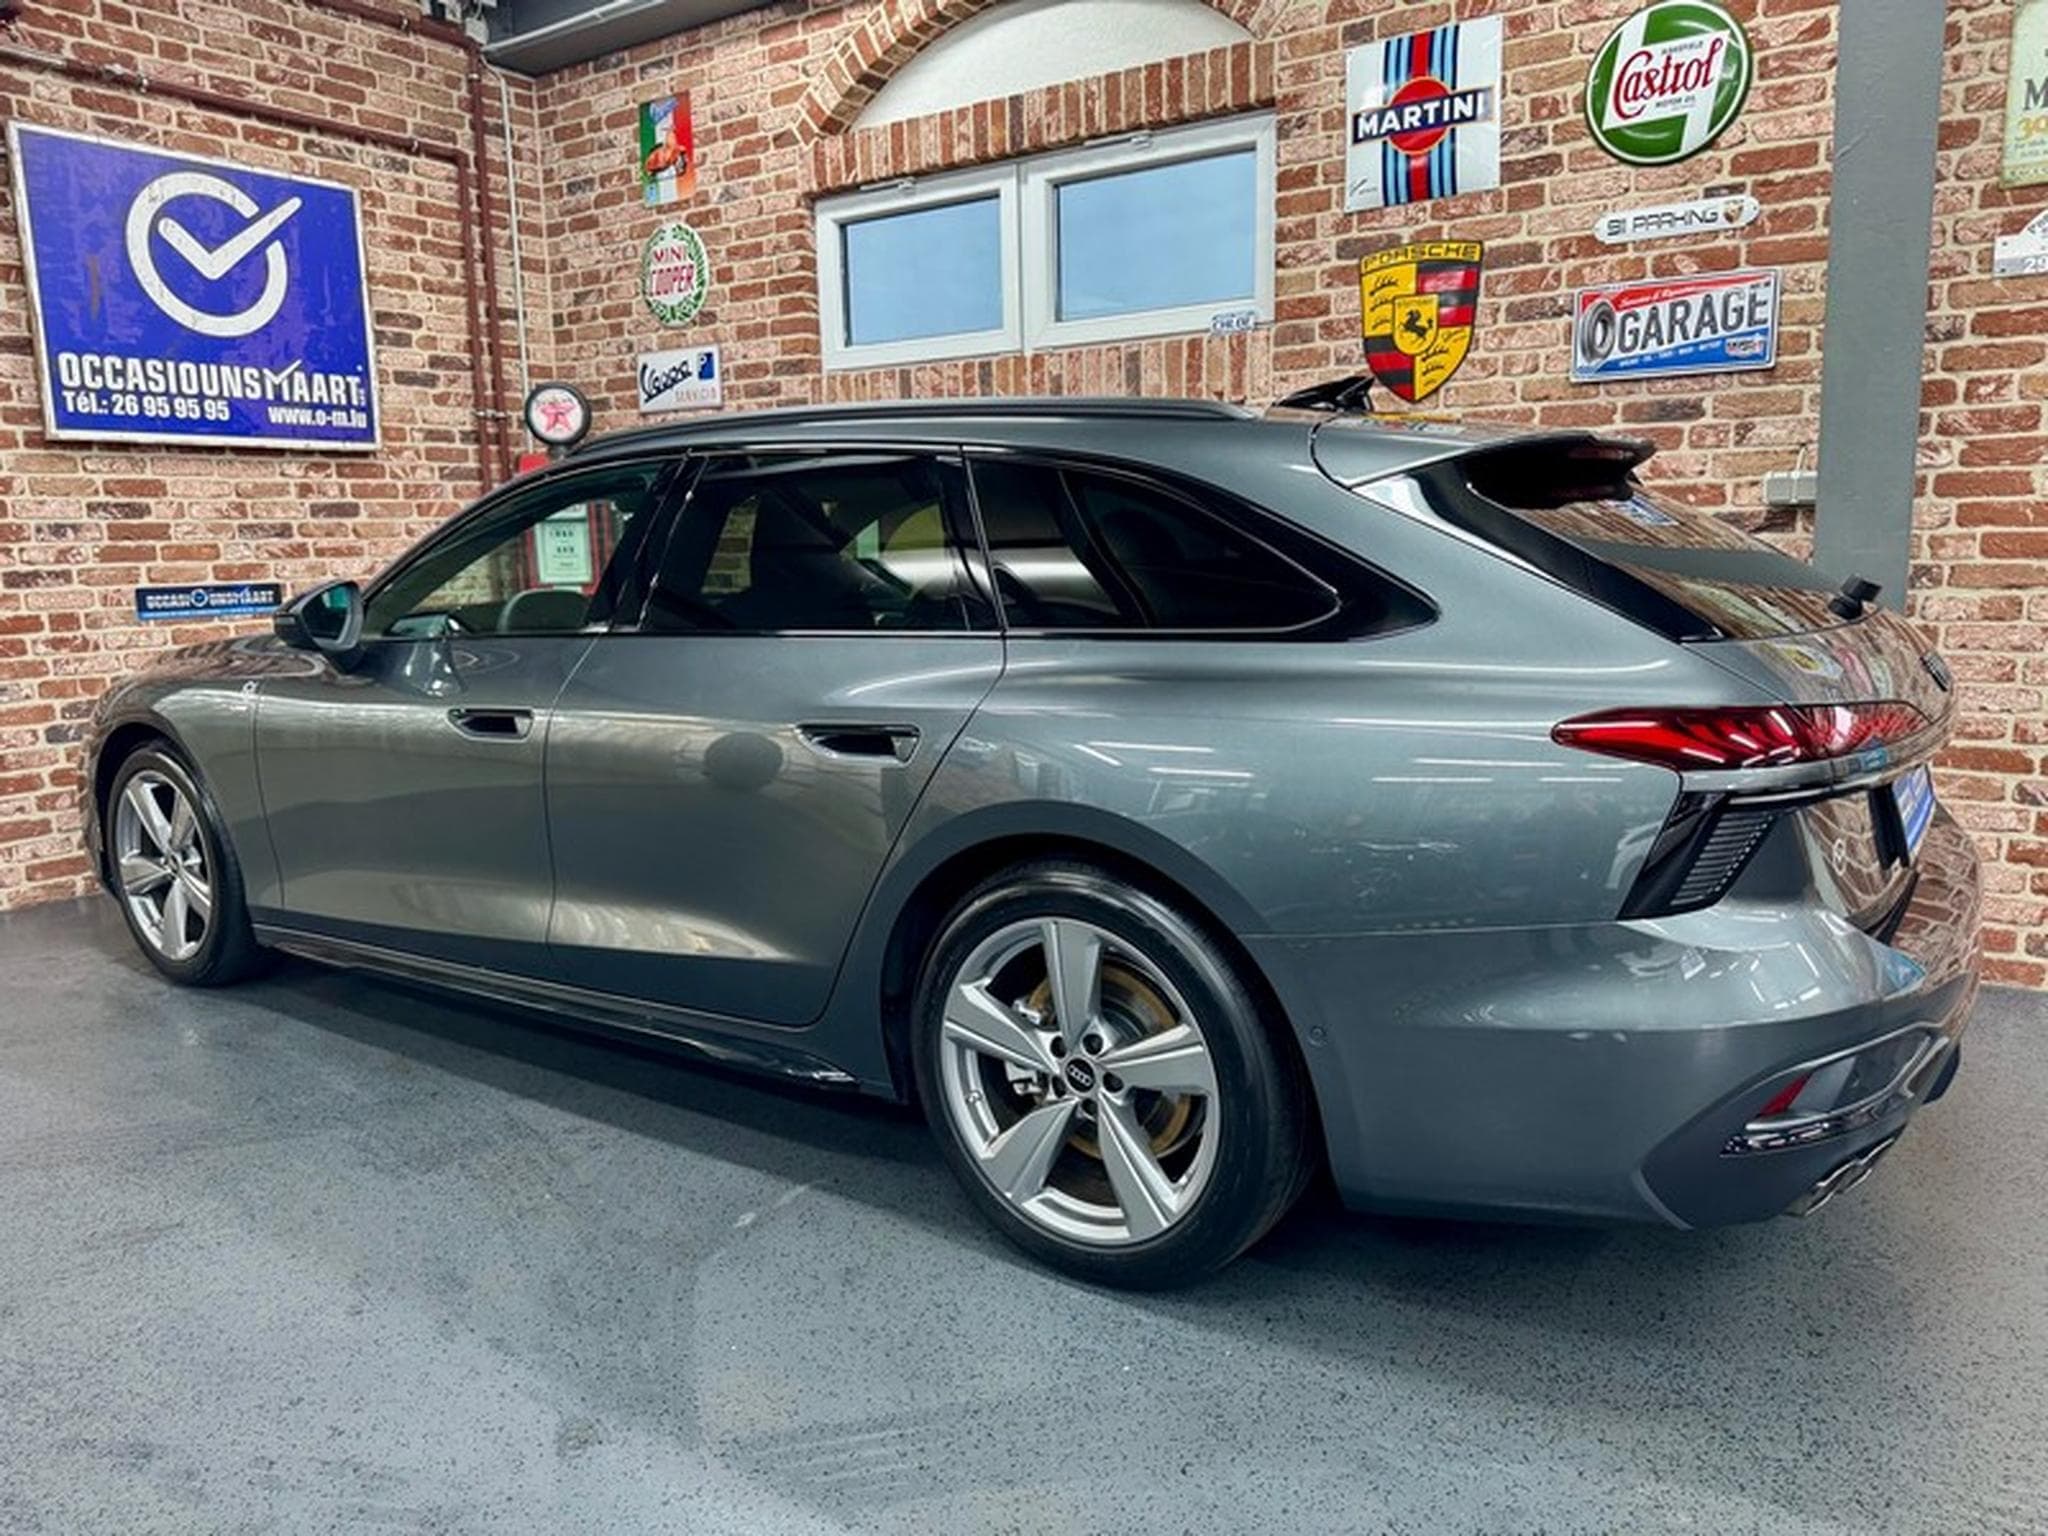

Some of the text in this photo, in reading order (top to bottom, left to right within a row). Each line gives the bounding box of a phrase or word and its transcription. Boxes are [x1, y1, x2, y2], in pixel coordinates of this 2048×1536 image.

[1612, 37, 1724, 120] Castrol
[1357, 92, 1485, 139] MARTINI
[1632, 209, 1719, 232] PARKING
[653, 245, 687, 262] MINI
[1363, 244, 1478, 270] PORSCHE
[650, 264, 694, 297] COOPER
[1617, 280, 1771, 354] GARAGE
[58, 352, 360, 406] OCCASIOUNSMAART
[111, 393, 140, 417] 26
[142, 396, 171, 418] 95
[174, 398, 201, 420] 95
[204, 400, 231, 421] 95
[268, 405, 366, 429] www.o-m.lu
